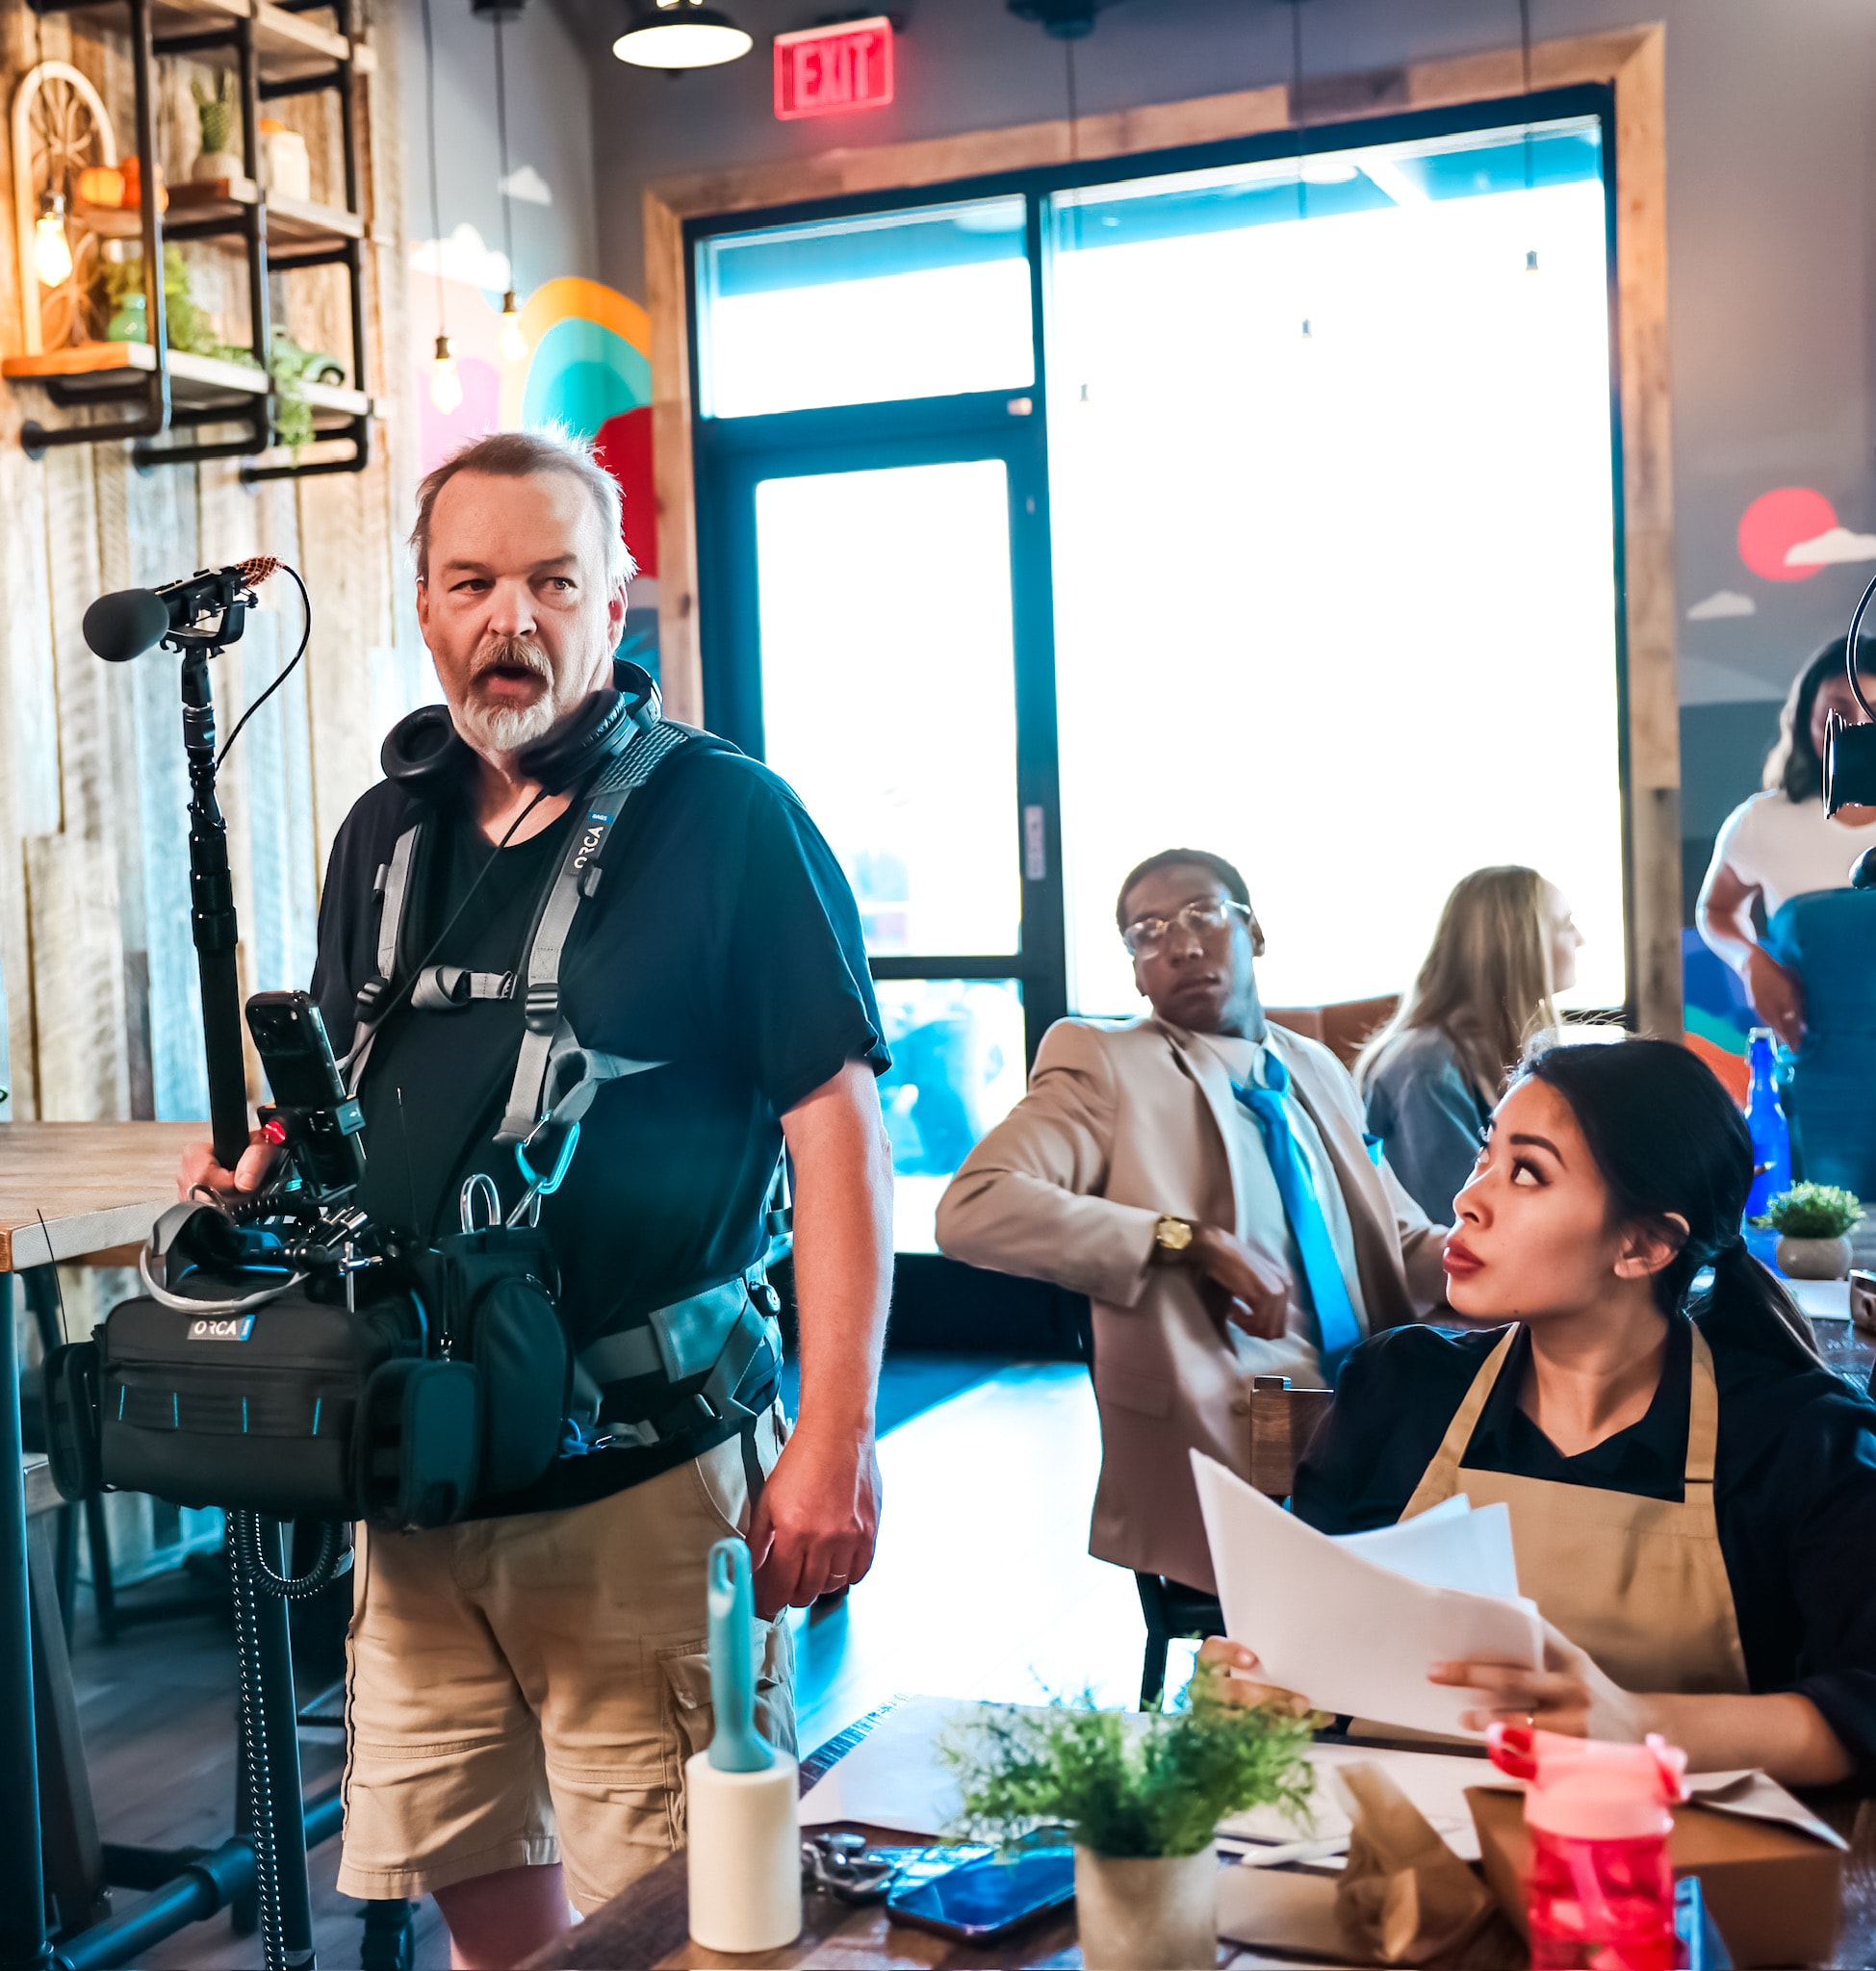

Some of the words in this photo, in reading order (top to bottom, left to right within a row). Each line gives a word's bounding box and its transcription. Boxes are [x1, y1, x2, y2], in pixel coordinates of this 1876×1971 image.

[793, 33, 874, 108] EXIT
[573, 826, 605, 869] ORCA
[193, 1319, 237, 1336] ORCA
